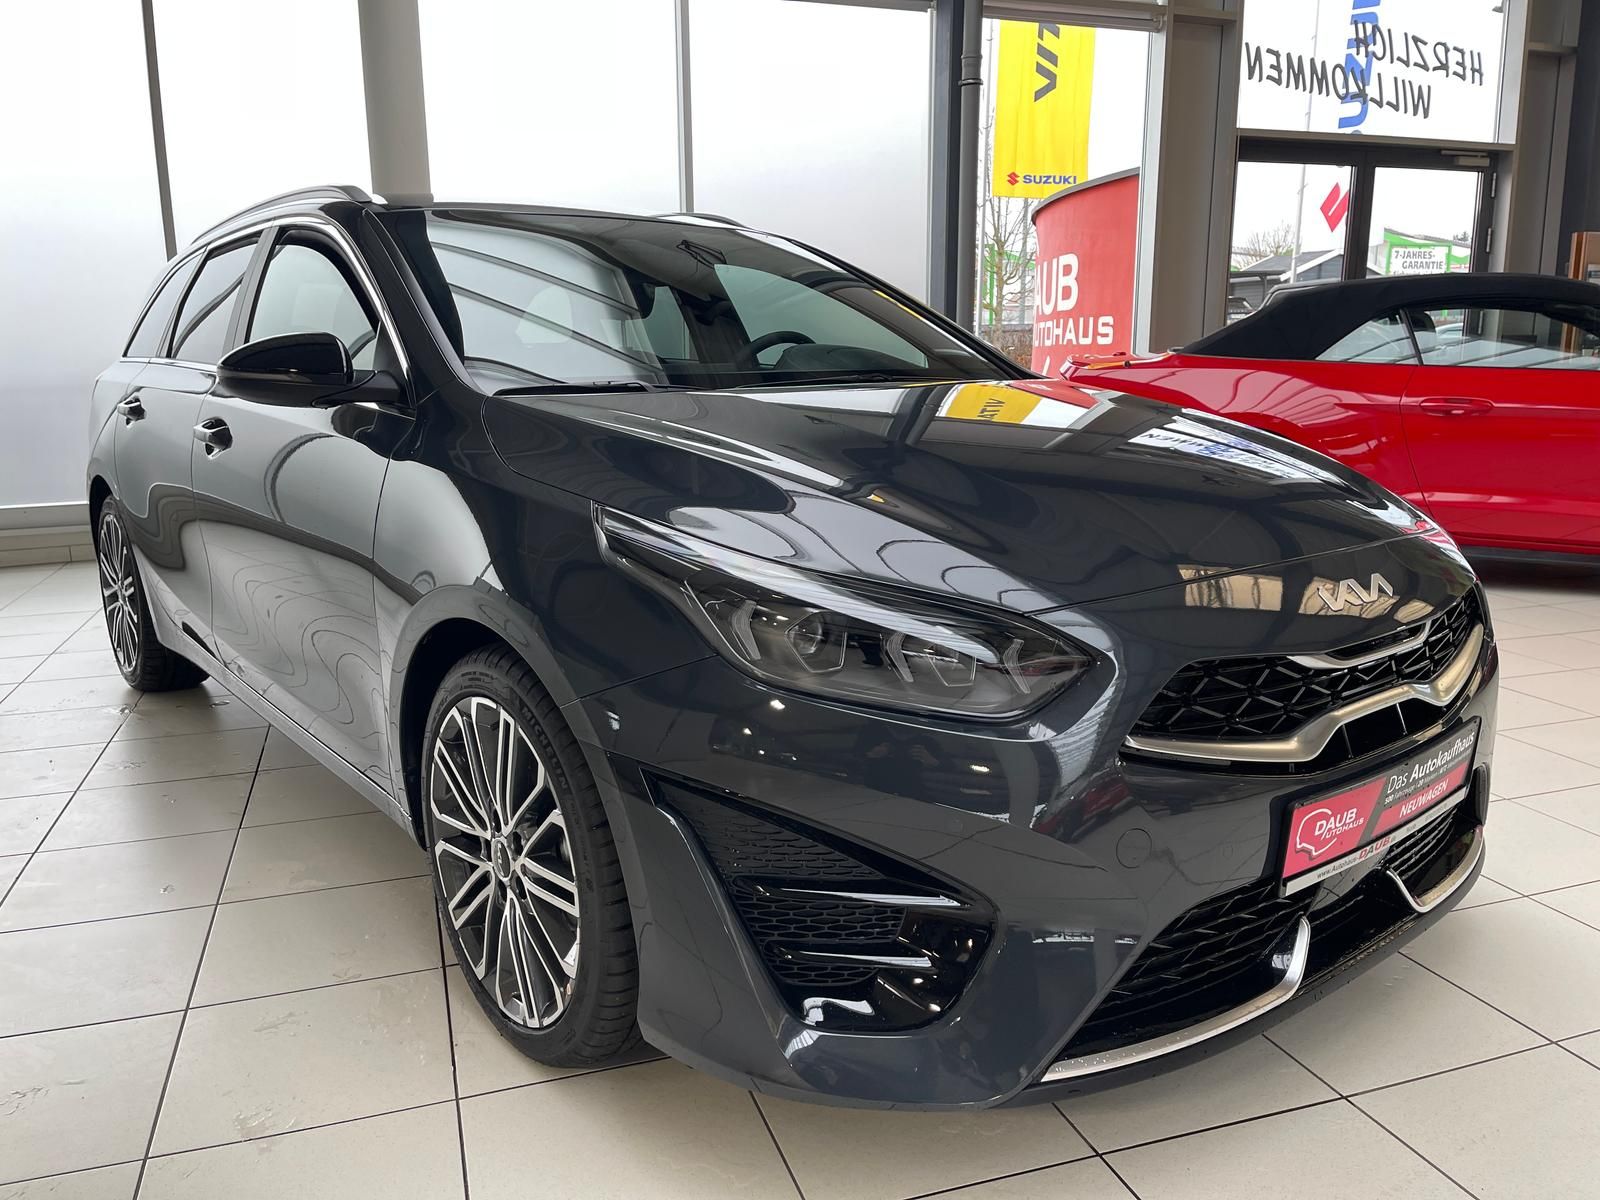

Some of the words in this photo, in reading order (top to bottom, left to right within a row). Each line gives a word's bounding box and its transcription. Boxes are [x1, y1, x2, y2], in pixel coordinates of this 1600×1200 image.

[1022, 174, 1077, 185] SUZUKI
[1401, 260, 1444, 270] GARANTIE
[1317, 572, 1394, 612] KIA
[520, 703, 571, 791] MICHELIN
[1387, 772, 1409, 794] Das
[1410, 732, 1475, 783] Autokaufhaus
[1399, 778, 1449, 818] NEUWAGEN
[1314, 807, 1357, 840] DAUB
